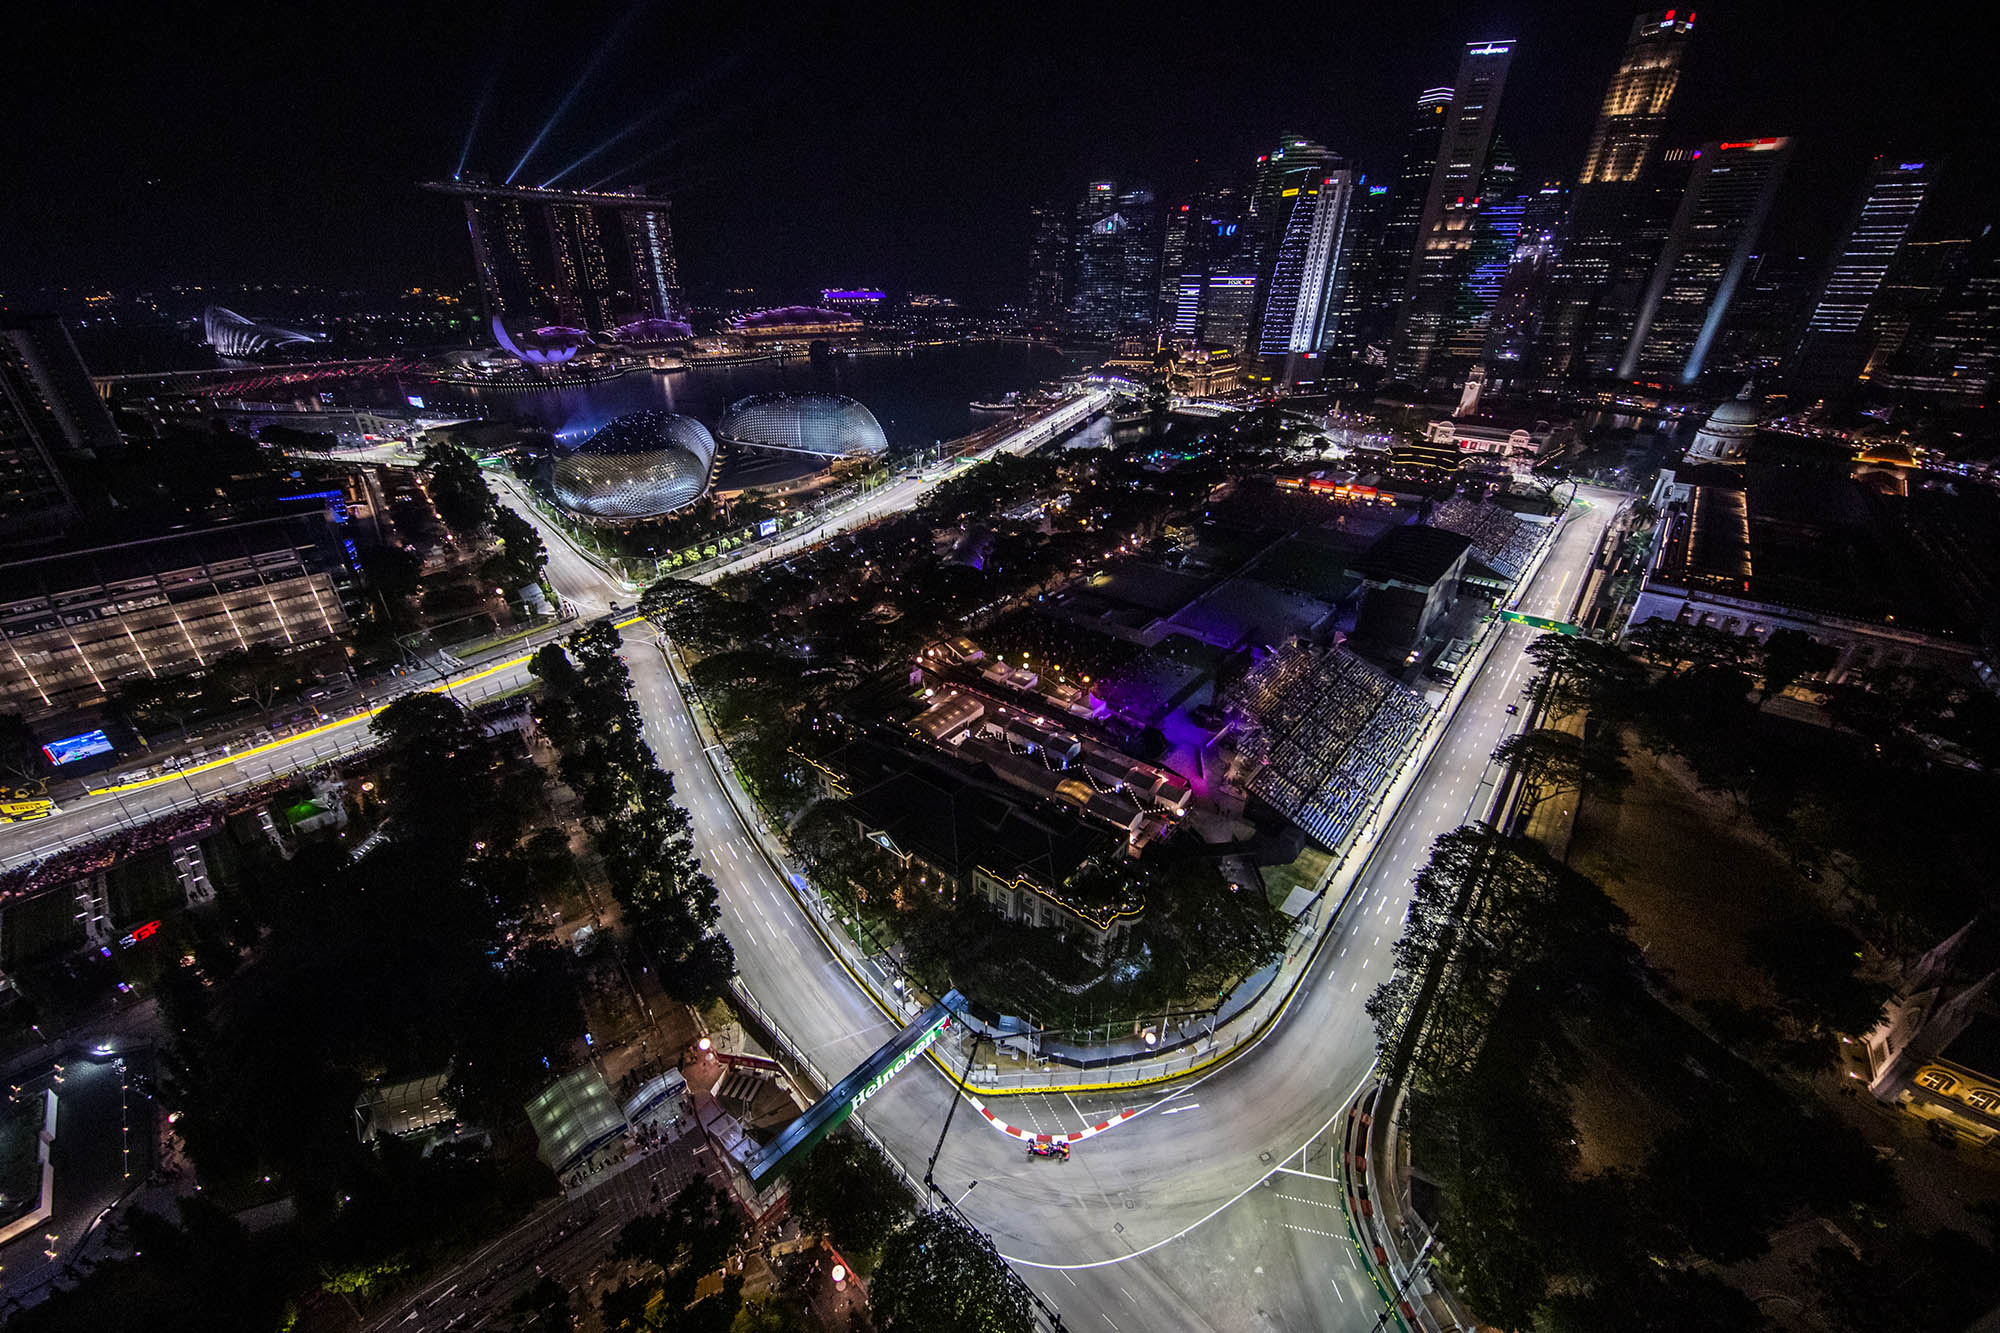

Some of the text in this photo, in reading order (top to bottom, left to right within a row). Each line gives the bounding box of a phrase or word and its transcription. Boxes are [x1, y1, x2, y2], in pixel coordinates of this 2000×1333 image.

[849, 1032, 937, 1112] Heineken
[1121, 1073, 1176, 1087] SINGAPORE
[1005, 1085, 1064, 1093] SINGAPORE
